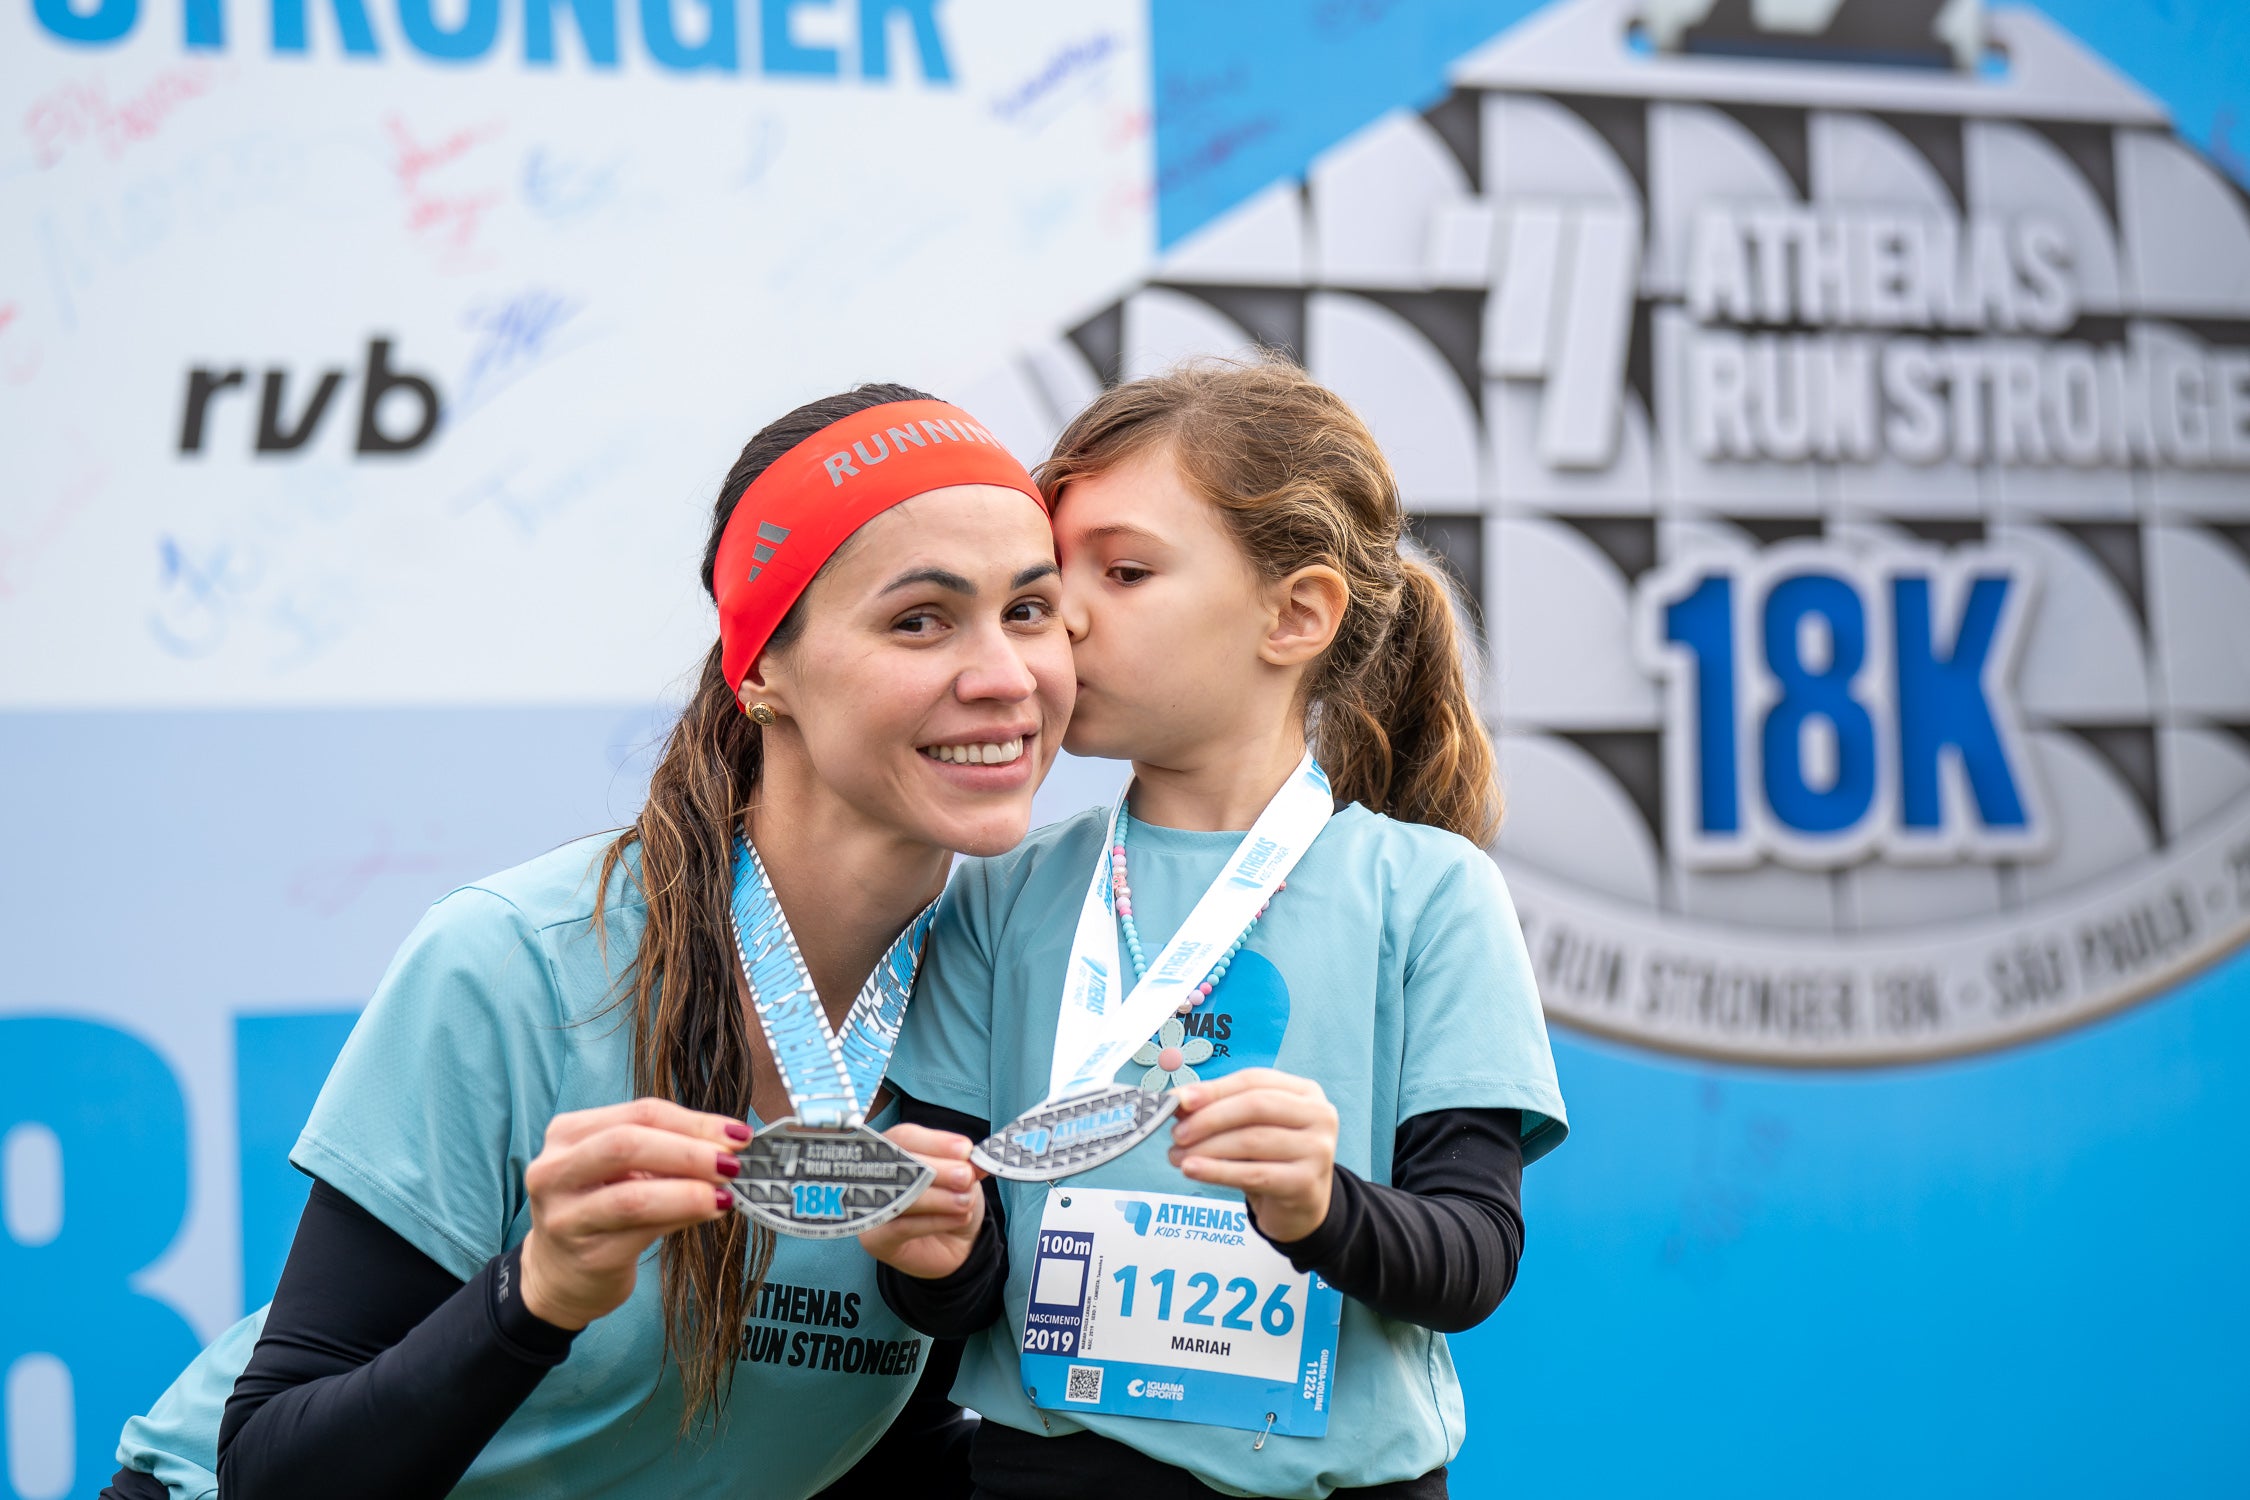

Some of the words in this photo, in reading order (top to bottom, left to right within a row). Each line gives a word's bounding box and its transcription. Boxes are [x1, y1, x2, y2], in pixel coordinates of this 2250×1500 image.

[1690, 211, 2078, 330] ATHENAS
[178, 335, 443, 456] rvb
[1695, 334, 1882, 462] RUN
[823, 418, 1008, 487] RUNNIN
[1664, 572, 2029, 834] 18K
[1236, 837, 1278, 879] ATHENAS
[1053, 1104, 1137, 1139] ATHENAS
[807, 1144, 863, 1160] ATHENAS
[805, 1160, 831, 1175] RUN
[832, 1161, 898, 1178] STRONGER
[793, 1184, 843, 1216] 18K
[1156, 1203, 1247, 1232] ATHENAS
[1041, 1235, 1091, 1256] 100m
[1154, 1225, 1181, 1238] KIDS
[1185, 1230, 1246, 1246] STRONGER
[1113, 1265, 1295, 1336] 11226
[1028, 1313, 1081, 1327] NASCIMENTO
[787, 1331, 921, 1376] STRONGER
[1024, 1328, 1074, 1352] 2019
[1171, 1336, 1231, 1356] MARIAH
[1145, 1388, 1184, 1401] SPORTS
[1147, 1381, 1184, 1393] IGUANA
[1303, 1361, 1318, 1400] 11226
